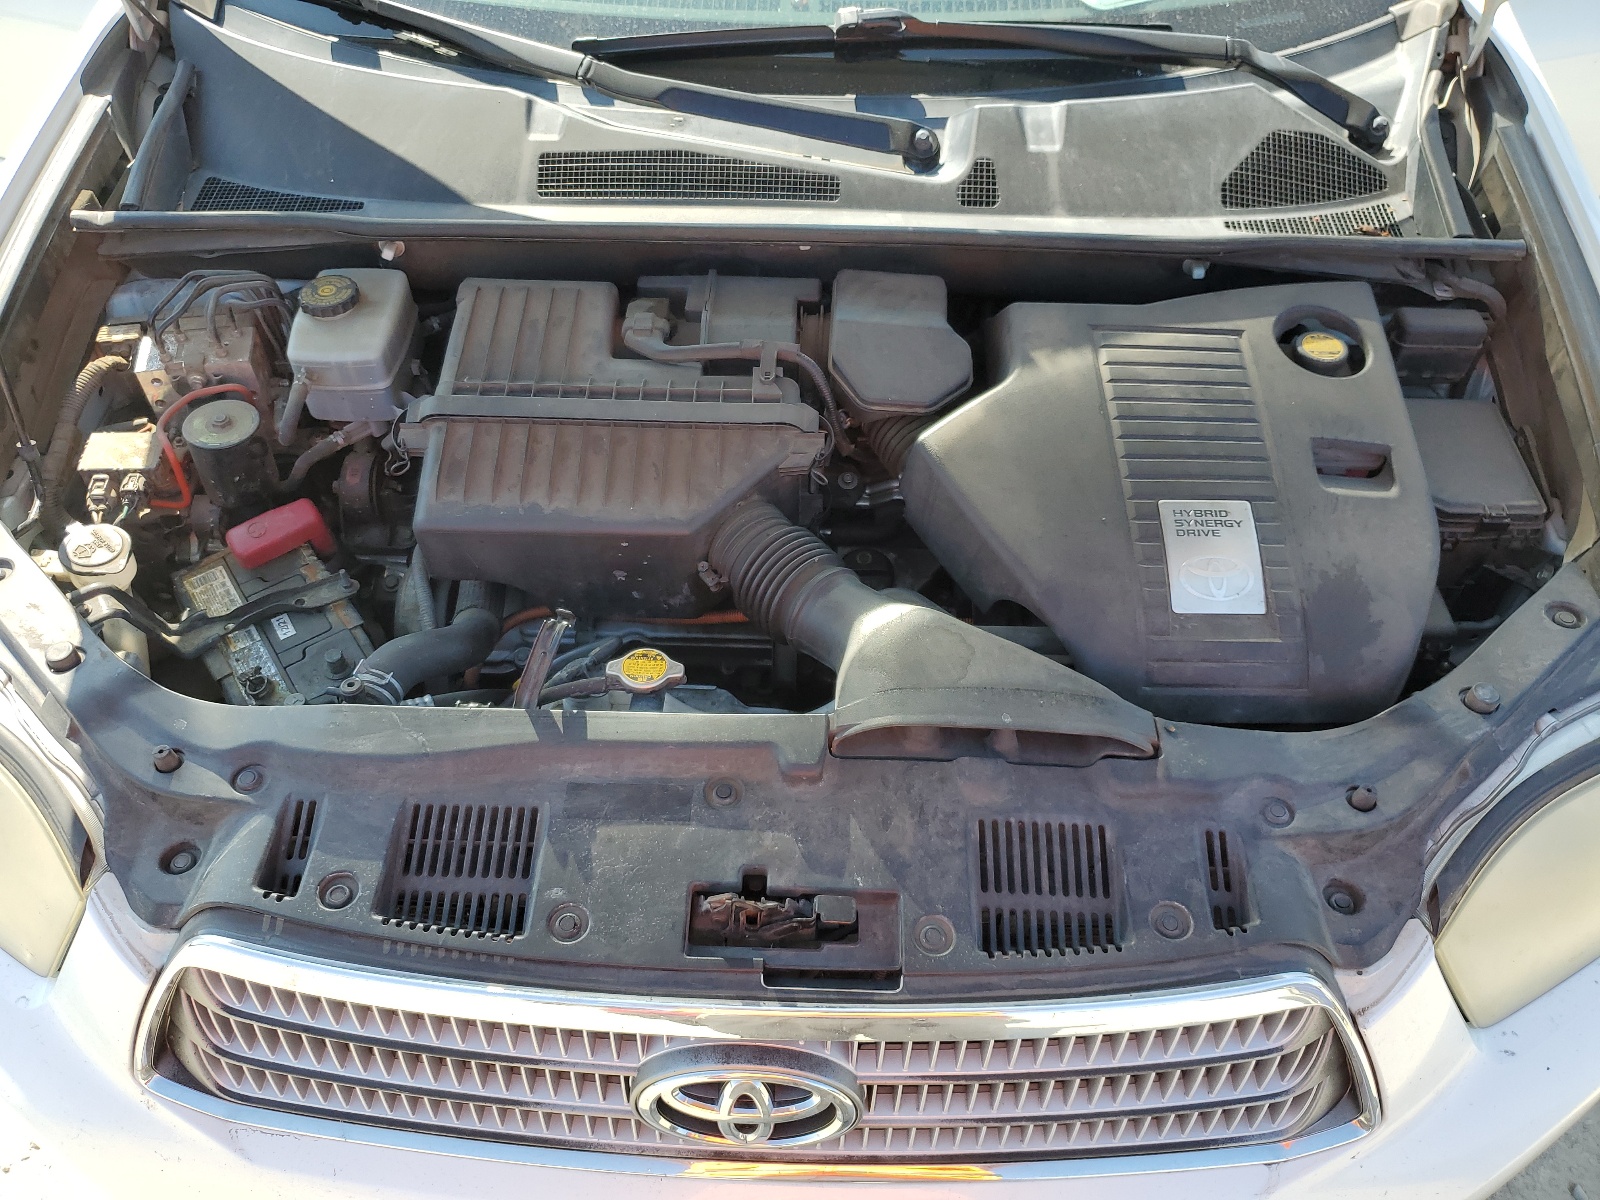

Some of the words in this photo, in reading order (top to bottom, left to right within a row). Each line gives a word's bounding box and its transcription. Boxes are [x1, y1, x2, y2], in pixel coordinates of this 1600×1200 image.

[1172, 509, 1229, 518] HYBRID
[1174, 519, 1243, 528] SYNERGY
[1175, 529, 1221, 537] DRIVE
